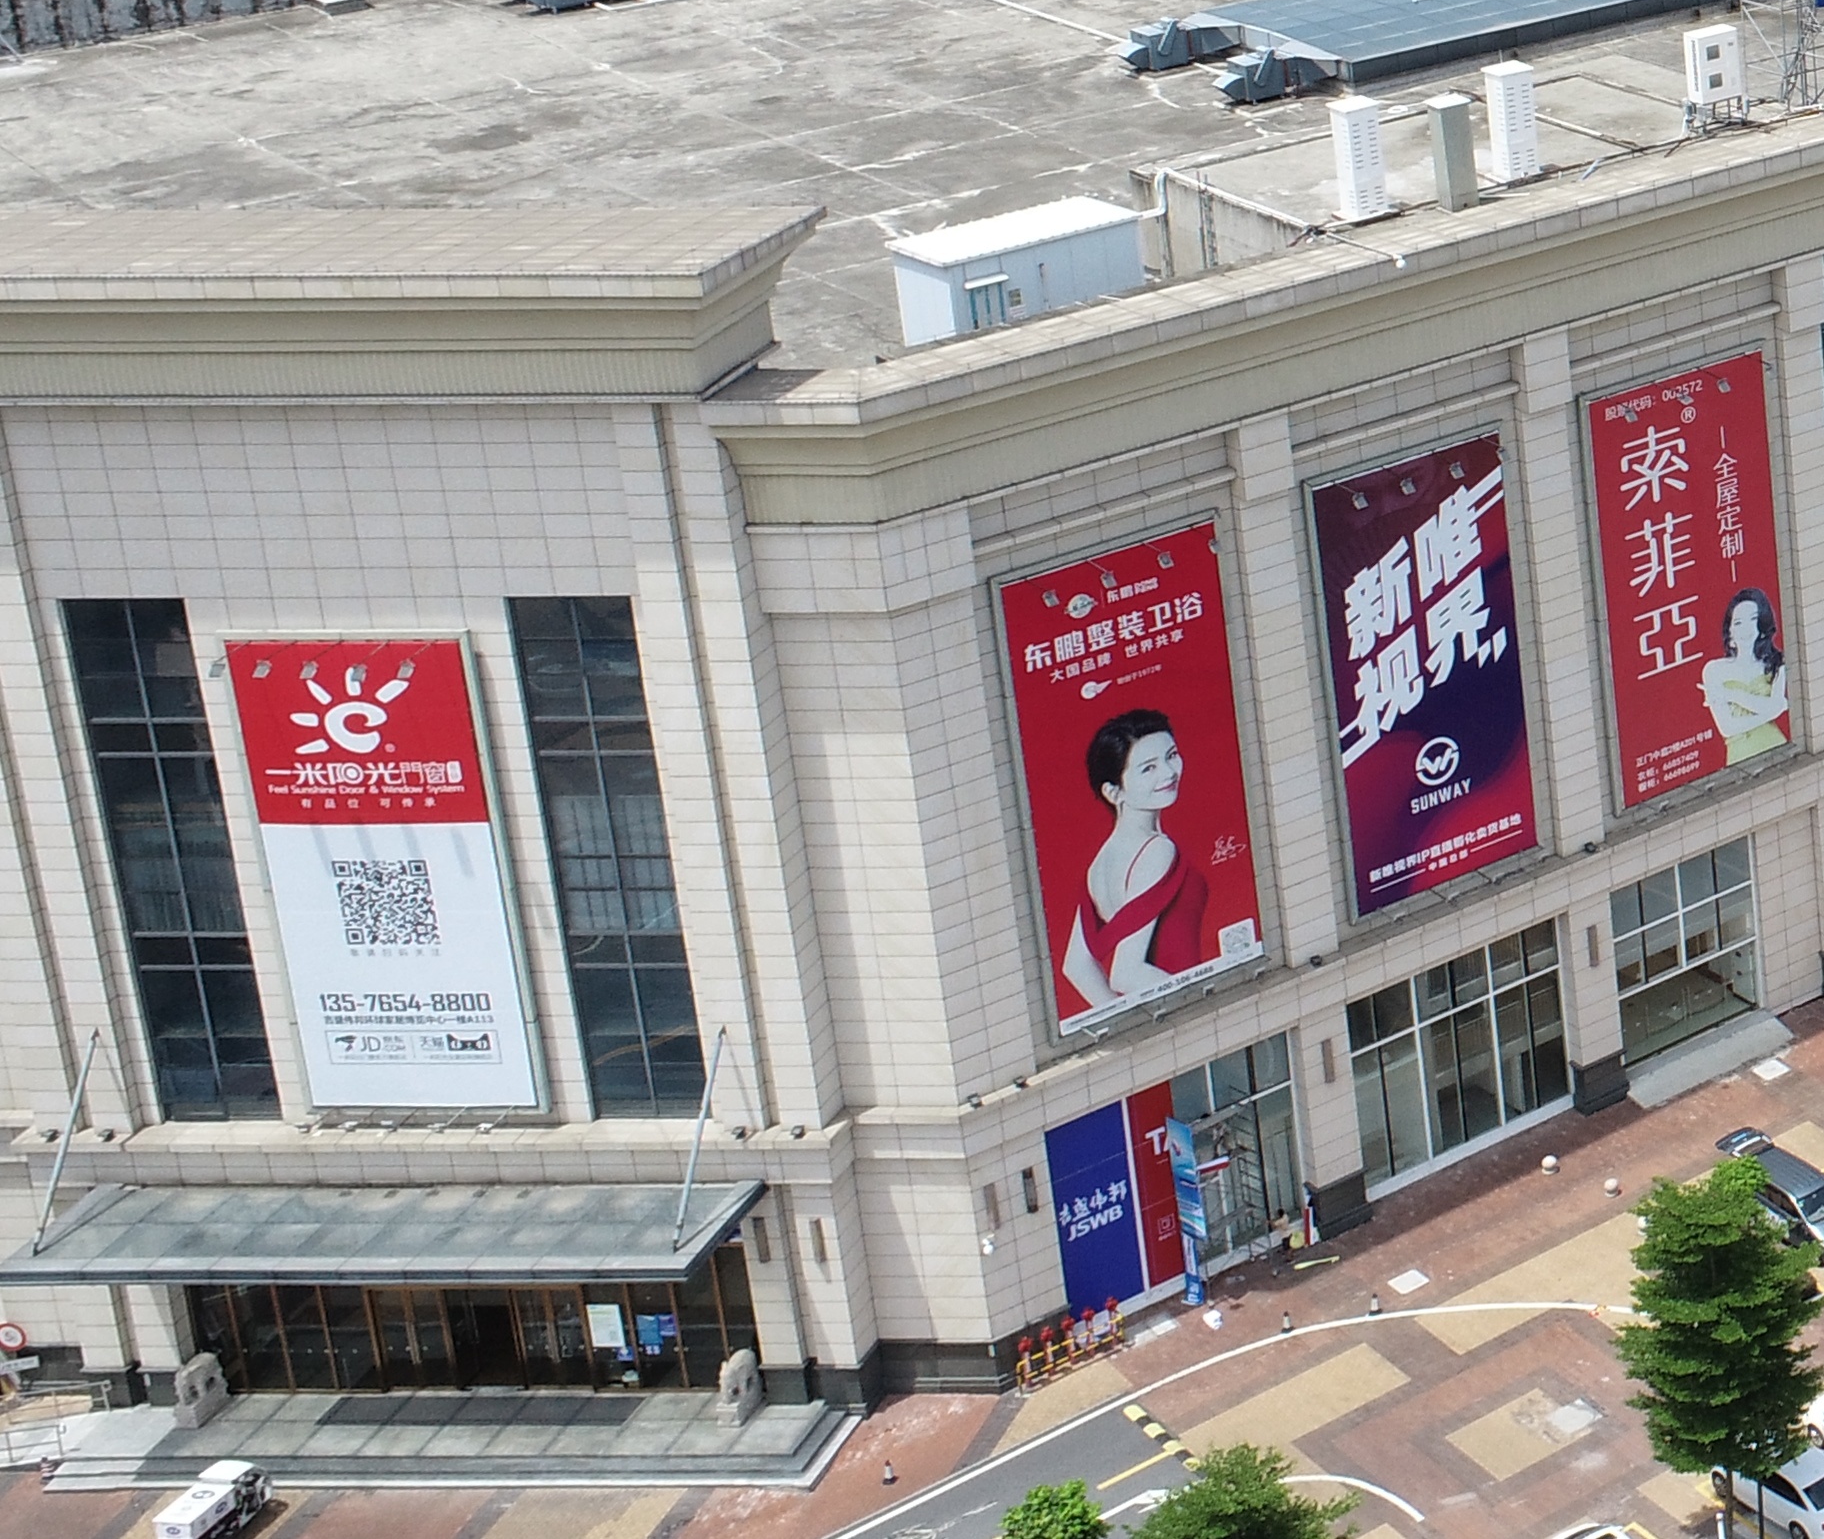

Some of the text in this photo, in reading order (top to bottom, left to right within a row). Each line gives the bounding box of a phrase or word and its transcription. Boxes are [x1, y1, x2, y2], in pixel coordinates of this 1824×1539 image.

[1713, 452, 1745, 561] 全屋定制
[1620, 425, 1704, 681] 索菲亞
[1023, 592, 1203, 673] 东鹏整装卫浴
[1050, 628, 1185, 684] 大国品牌 世界共享
[268, 784, 465, 796] Feel Sunshine Door & Window System
[1410, 778, 1472, 815] SUNWAY
[320, 993, 492, 1012] 135-7654-8800
[360, 1036, 382, 1053] JD
[1067, 1204, 1124, 1243] JSWB
